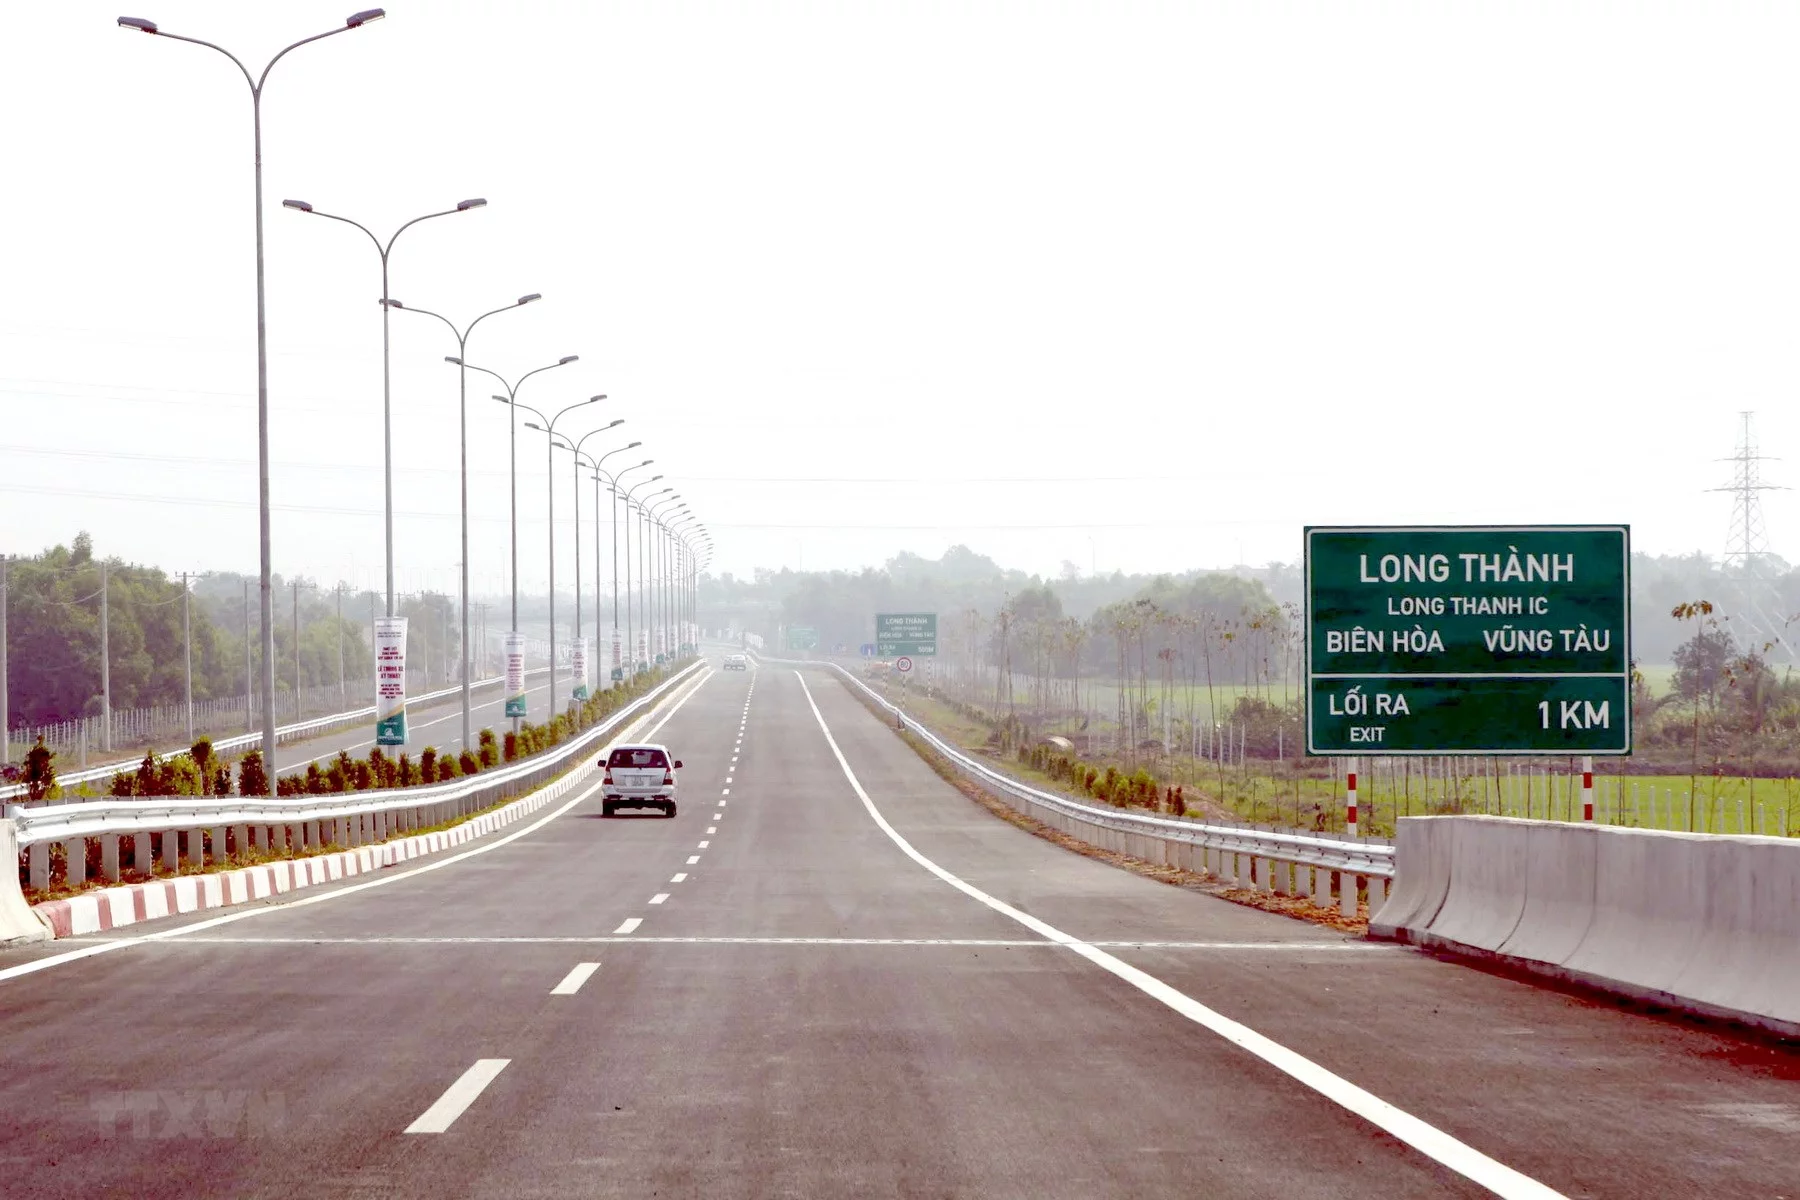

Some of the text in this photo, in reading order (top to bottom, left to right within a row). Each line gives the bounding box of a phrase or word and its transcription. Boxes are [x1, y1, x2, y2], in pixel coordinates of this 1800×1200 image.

[1361, 546, 1572, 582] LONG THÀNH
[1389, 597, 1547, 615] LONG THANH IC
[1328, 625, 1444, 652] BIÊN HÒA
[1484, 624, 1609, 651] VŨNG TÀU
[1330, 686, 1409, 715] LỐI RA
[1539, 701, 1608, 728] 1 KM
[1351, 727, 1385, 741] EXIT
